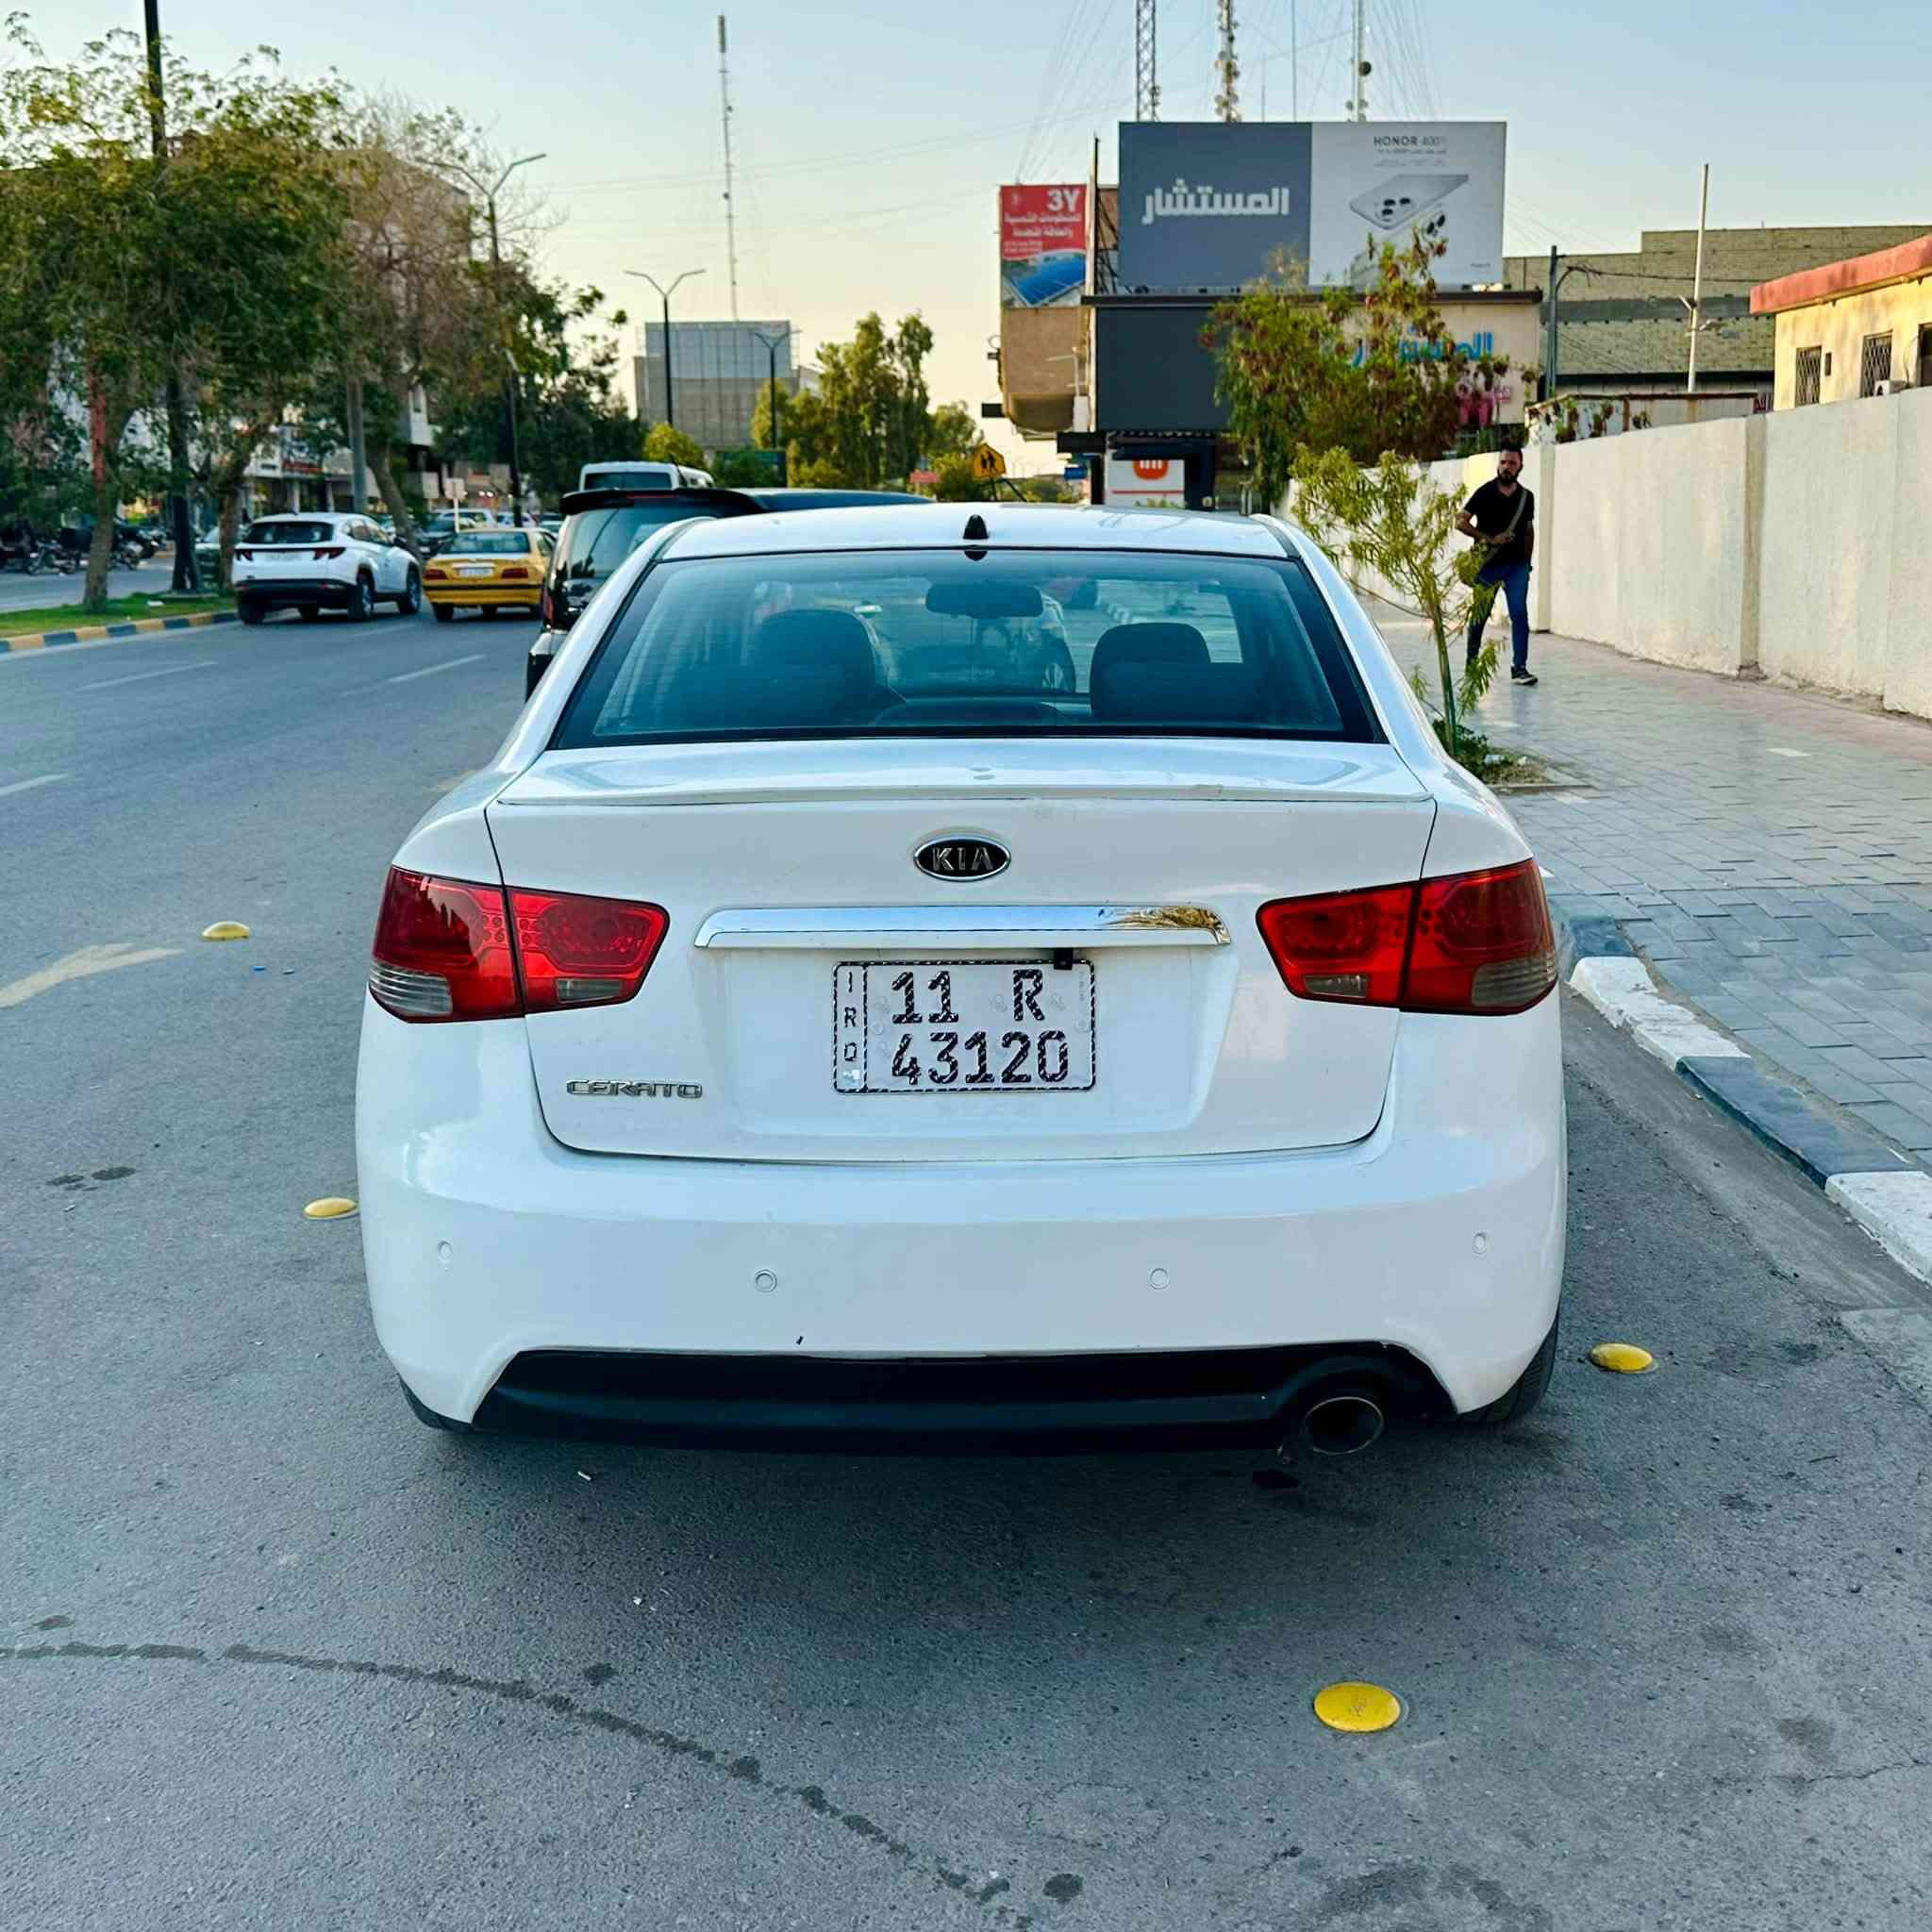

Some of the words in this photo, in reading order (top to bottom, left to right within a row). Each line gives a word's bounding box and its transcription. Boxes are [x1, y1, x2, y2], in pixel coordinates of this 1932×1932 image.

[1374, 136, 1417, 145] HONOR
[1046, 189, 1080, 212] 3Y
[1141, 178, 1290, 225] المستشار
[931, 847, 994, 870] KIA
[891, 970, 959, 1024] 11
[1012, 969, 1045, 1022] R
[891, 1029, 1070, 1086] 43120
[566, 1078, 703, 1099] CERATO
